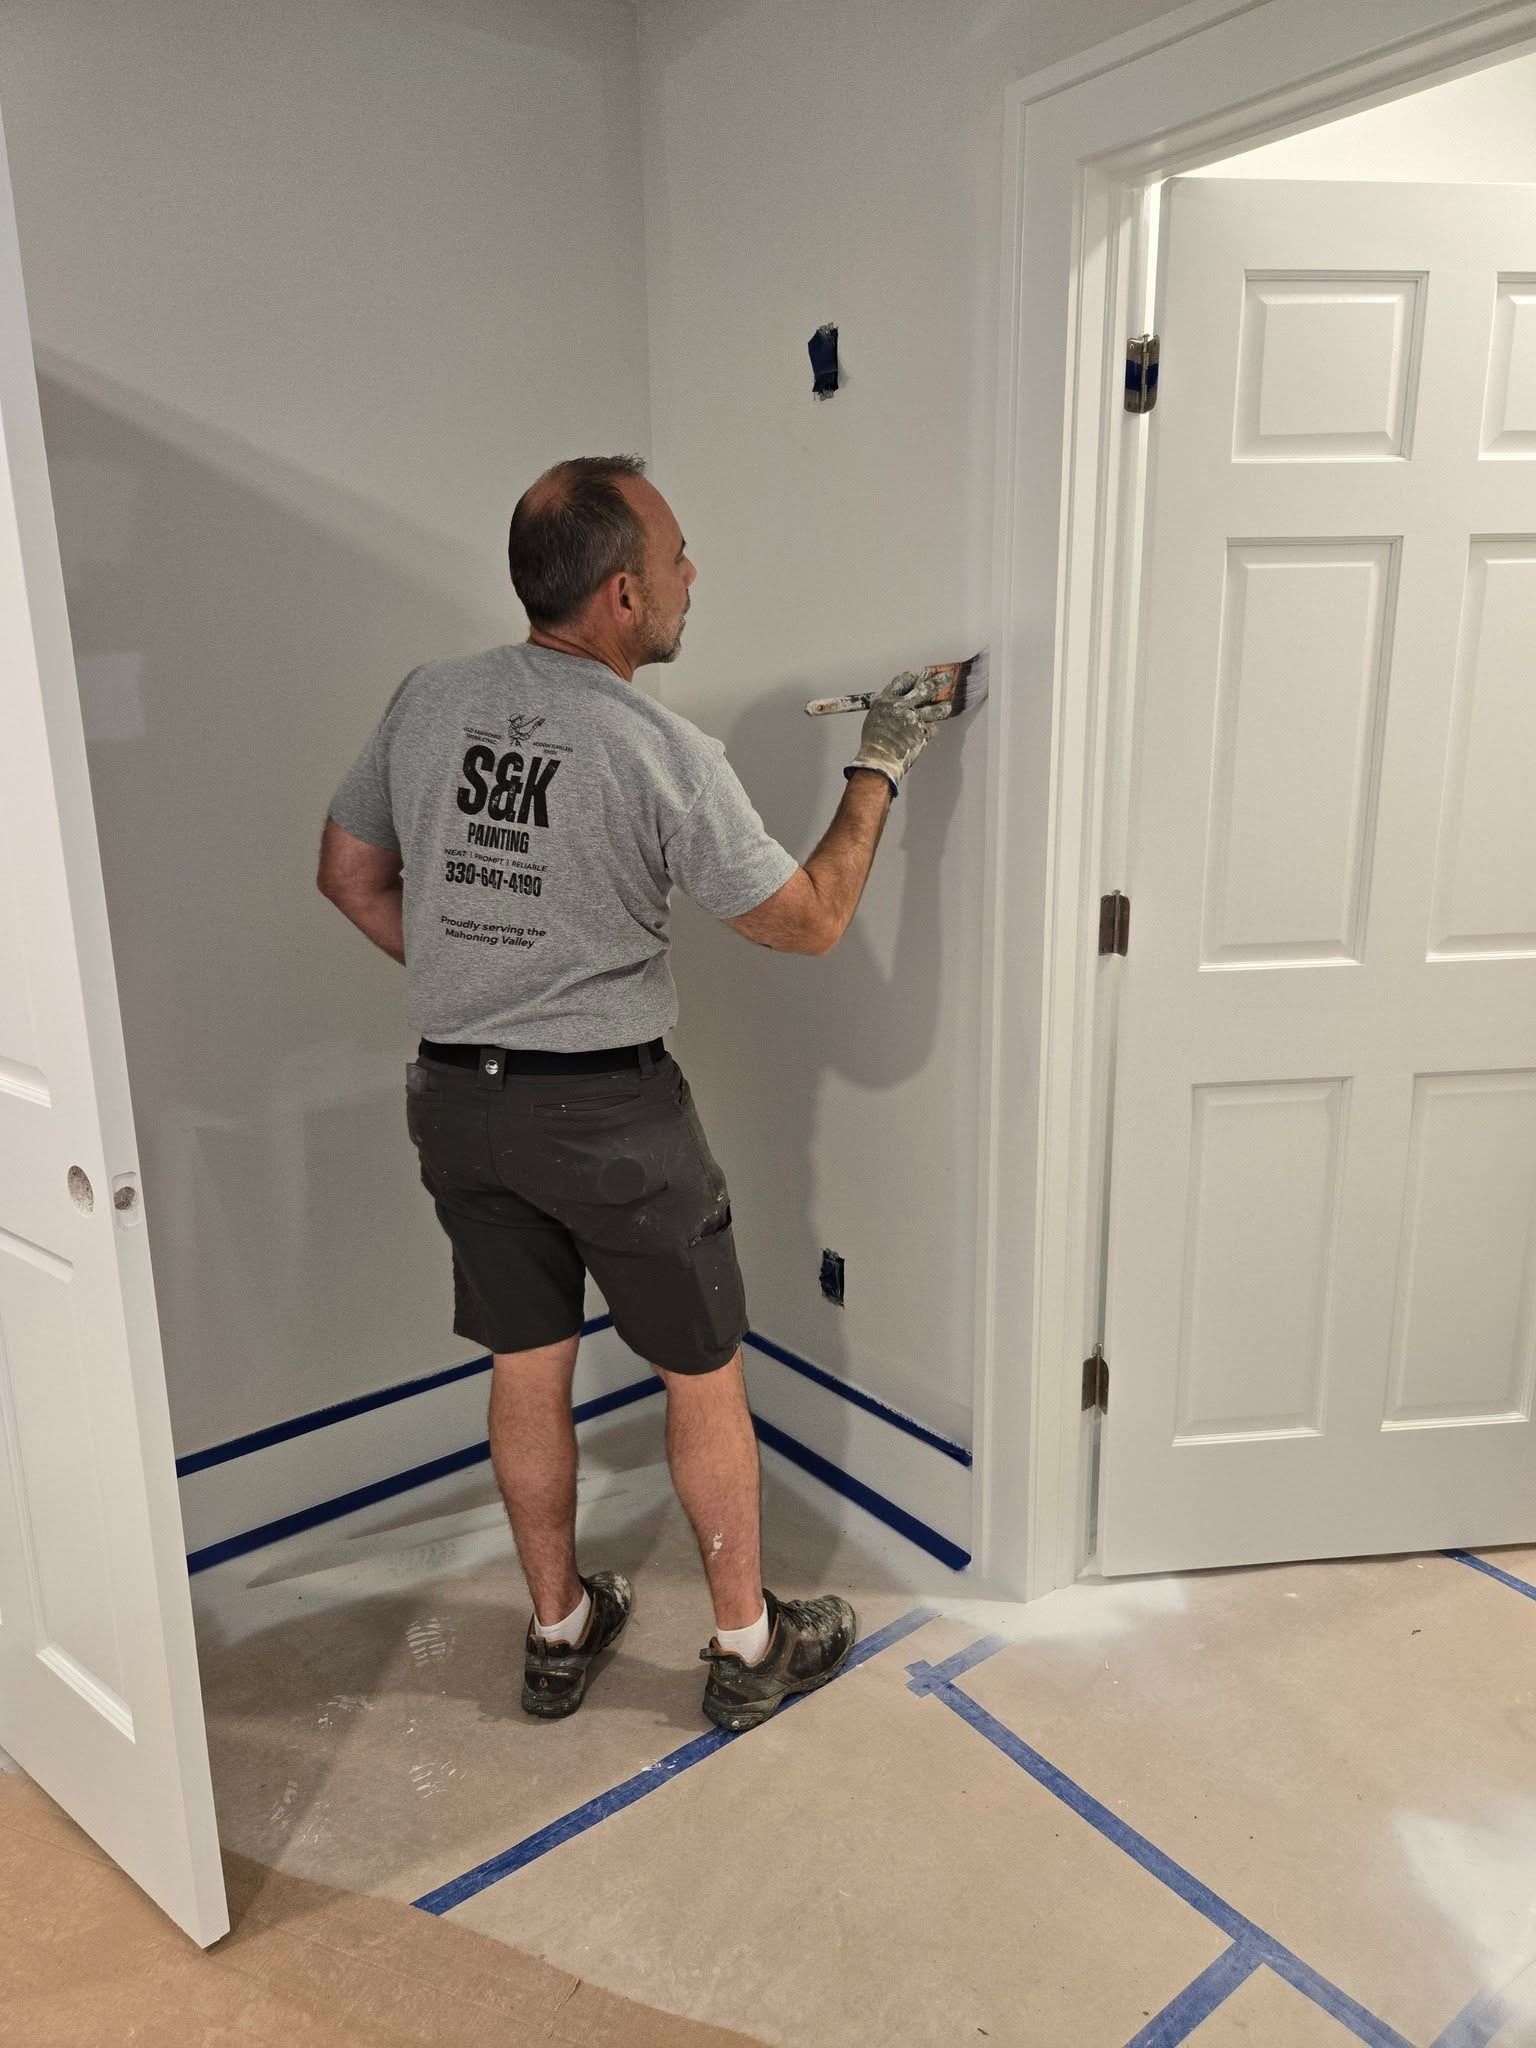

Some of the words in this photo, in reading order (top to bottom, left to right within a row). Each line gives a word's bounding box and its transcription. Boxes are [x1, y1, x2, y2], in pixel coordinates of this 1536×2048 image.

[457, 745, 561, 828] S&K
[467, 822, 530, 854] PAINTING
[444, 848, 467, 857] NEAT
[474, 853, 504, 865] PROMPT
[512, 860, 548, 872] RELIABLE
[445, 861, 543, 897] 330-647-4190
[441, 915, 481, 931] Proudly
[483, 923, 525, 937] serving
[526, 927, 547, 937] the
[445, 928, 498, 945] Mahoning
[501, 936, 535, 949] Valley
